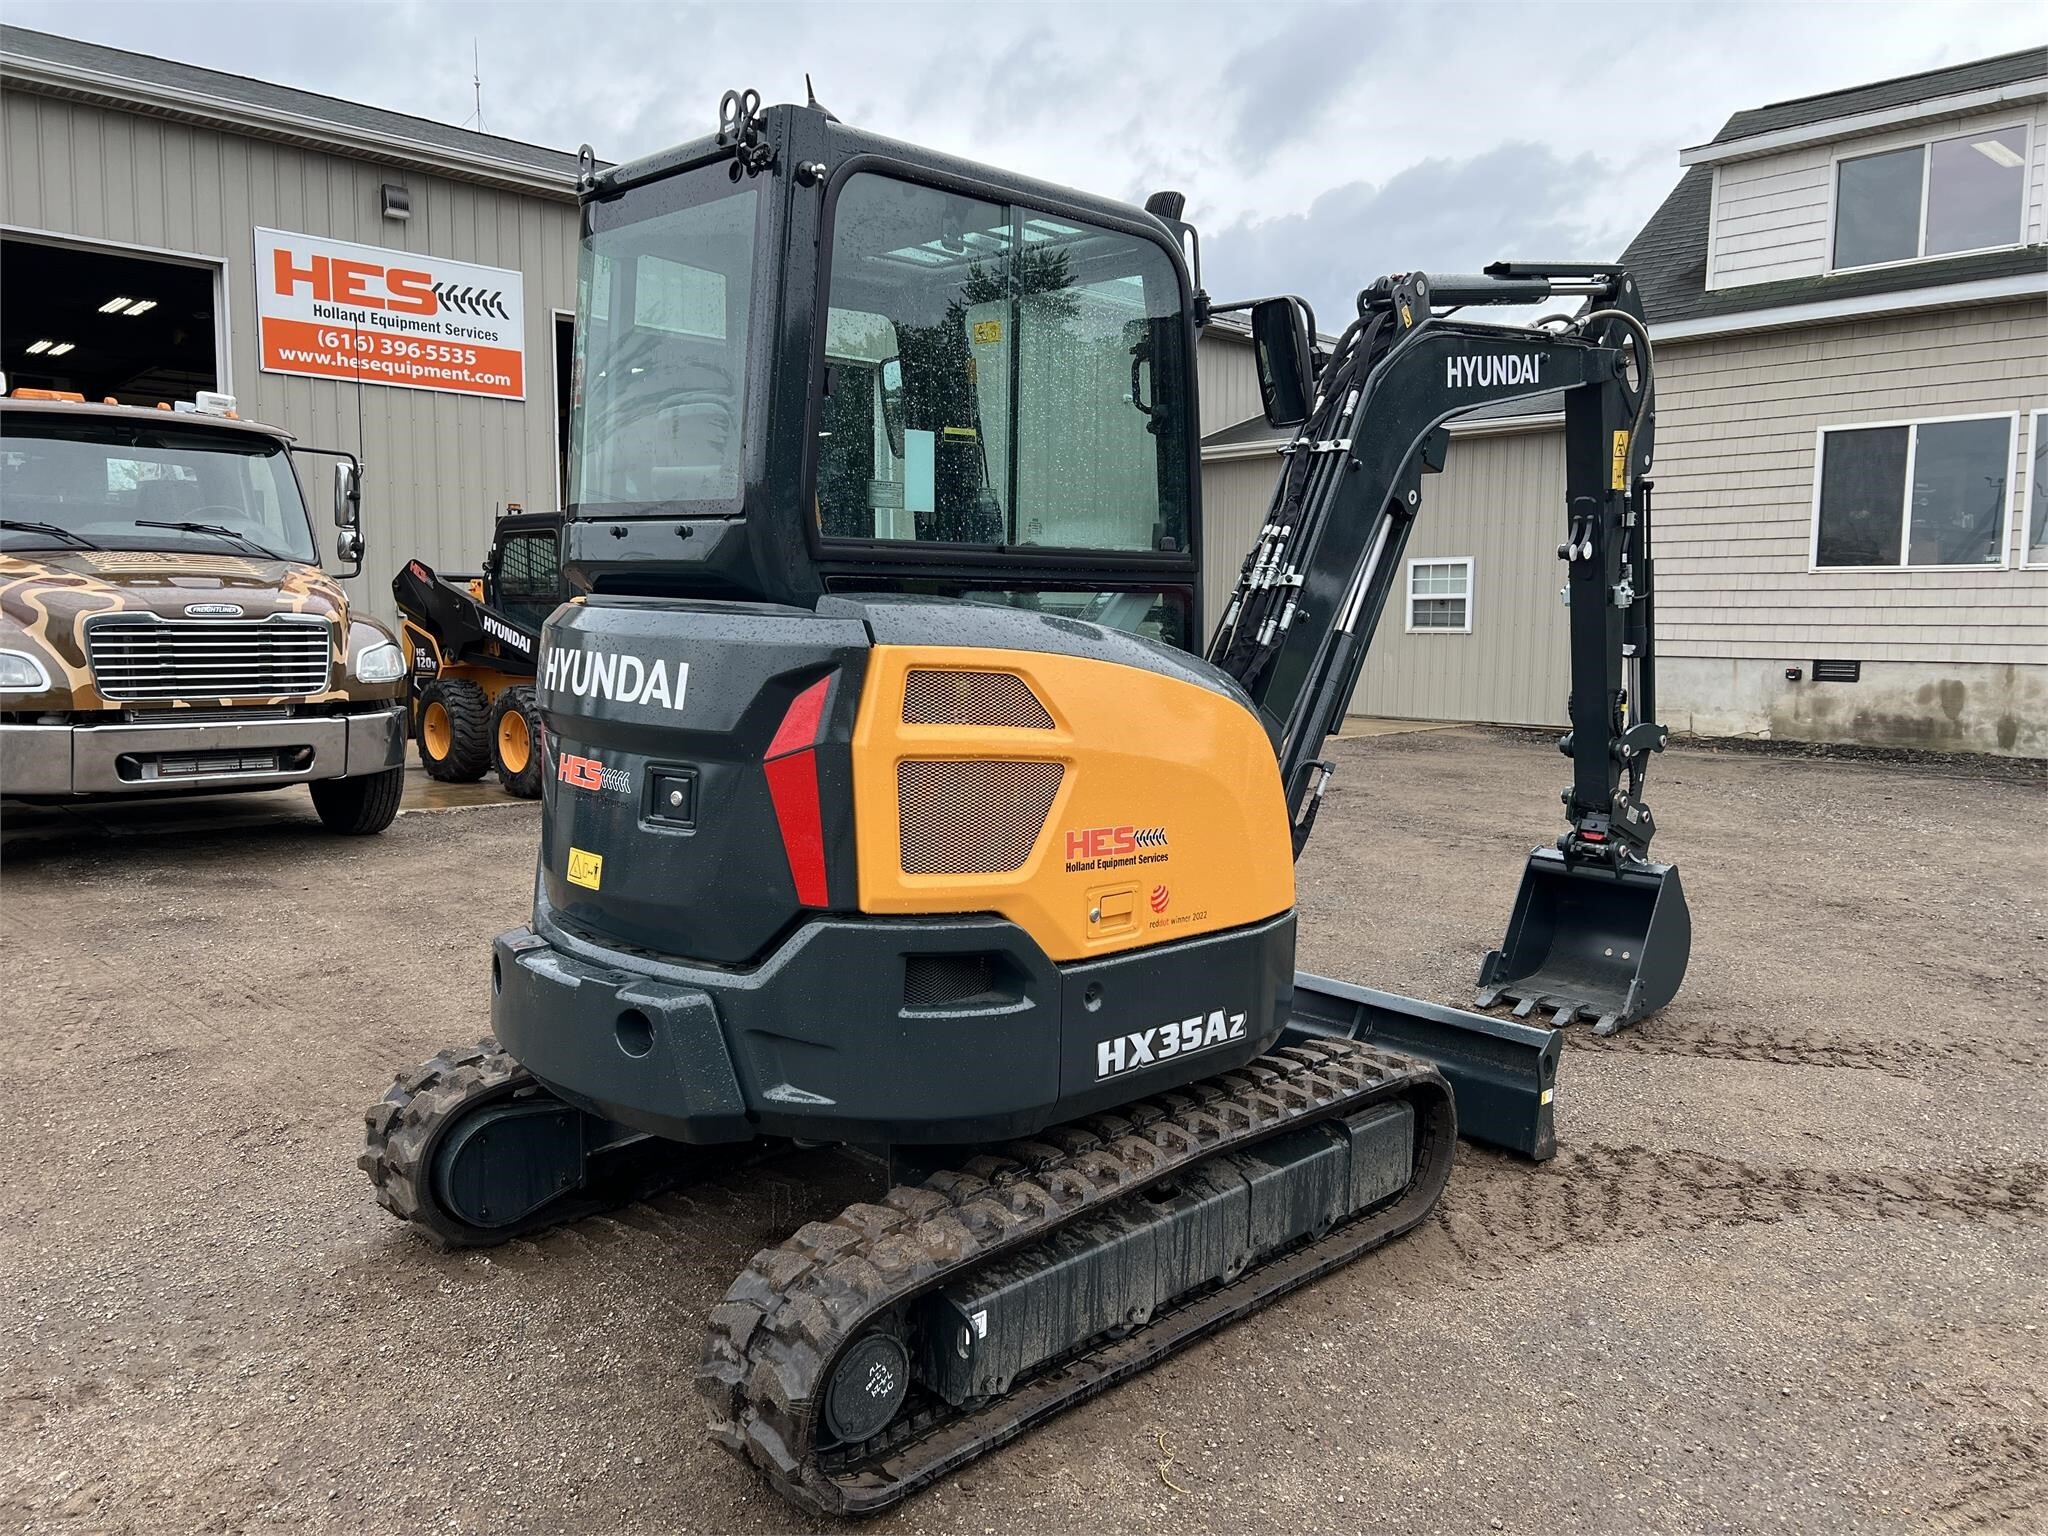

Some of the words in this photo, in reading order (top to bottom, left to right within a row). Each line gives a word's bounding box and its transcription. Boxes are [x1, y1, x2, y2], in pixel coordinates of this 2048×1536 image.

[273, 248, 439, 316] HES
[313, 304, 366, 323] Holland
[371, 312, 441, 334] Equipment
[445, 323, 499, 341] Services
[317, 329, 374, 353] (616)
[278, 348, 511, 386] www.hesequipment.com
[1447, 354, 1540, 388] HYUNDAI
[415, 648, 425, 656] HS
[483, 615, 531, 654] HYUNDAI
[544, 647, 690, 711] HYUNDAI
[558, 752, 603, 791] HES
[1065, 825, 1137, 860] HES
[1065, 860, 1095, 873] Holland
[1097, 856, 1137, 870] Equipment
[1138, 853, 1169, 865] Services
[1171, 915, 1191, 925] winner
[1192, 911, 1208, 921] 2022
